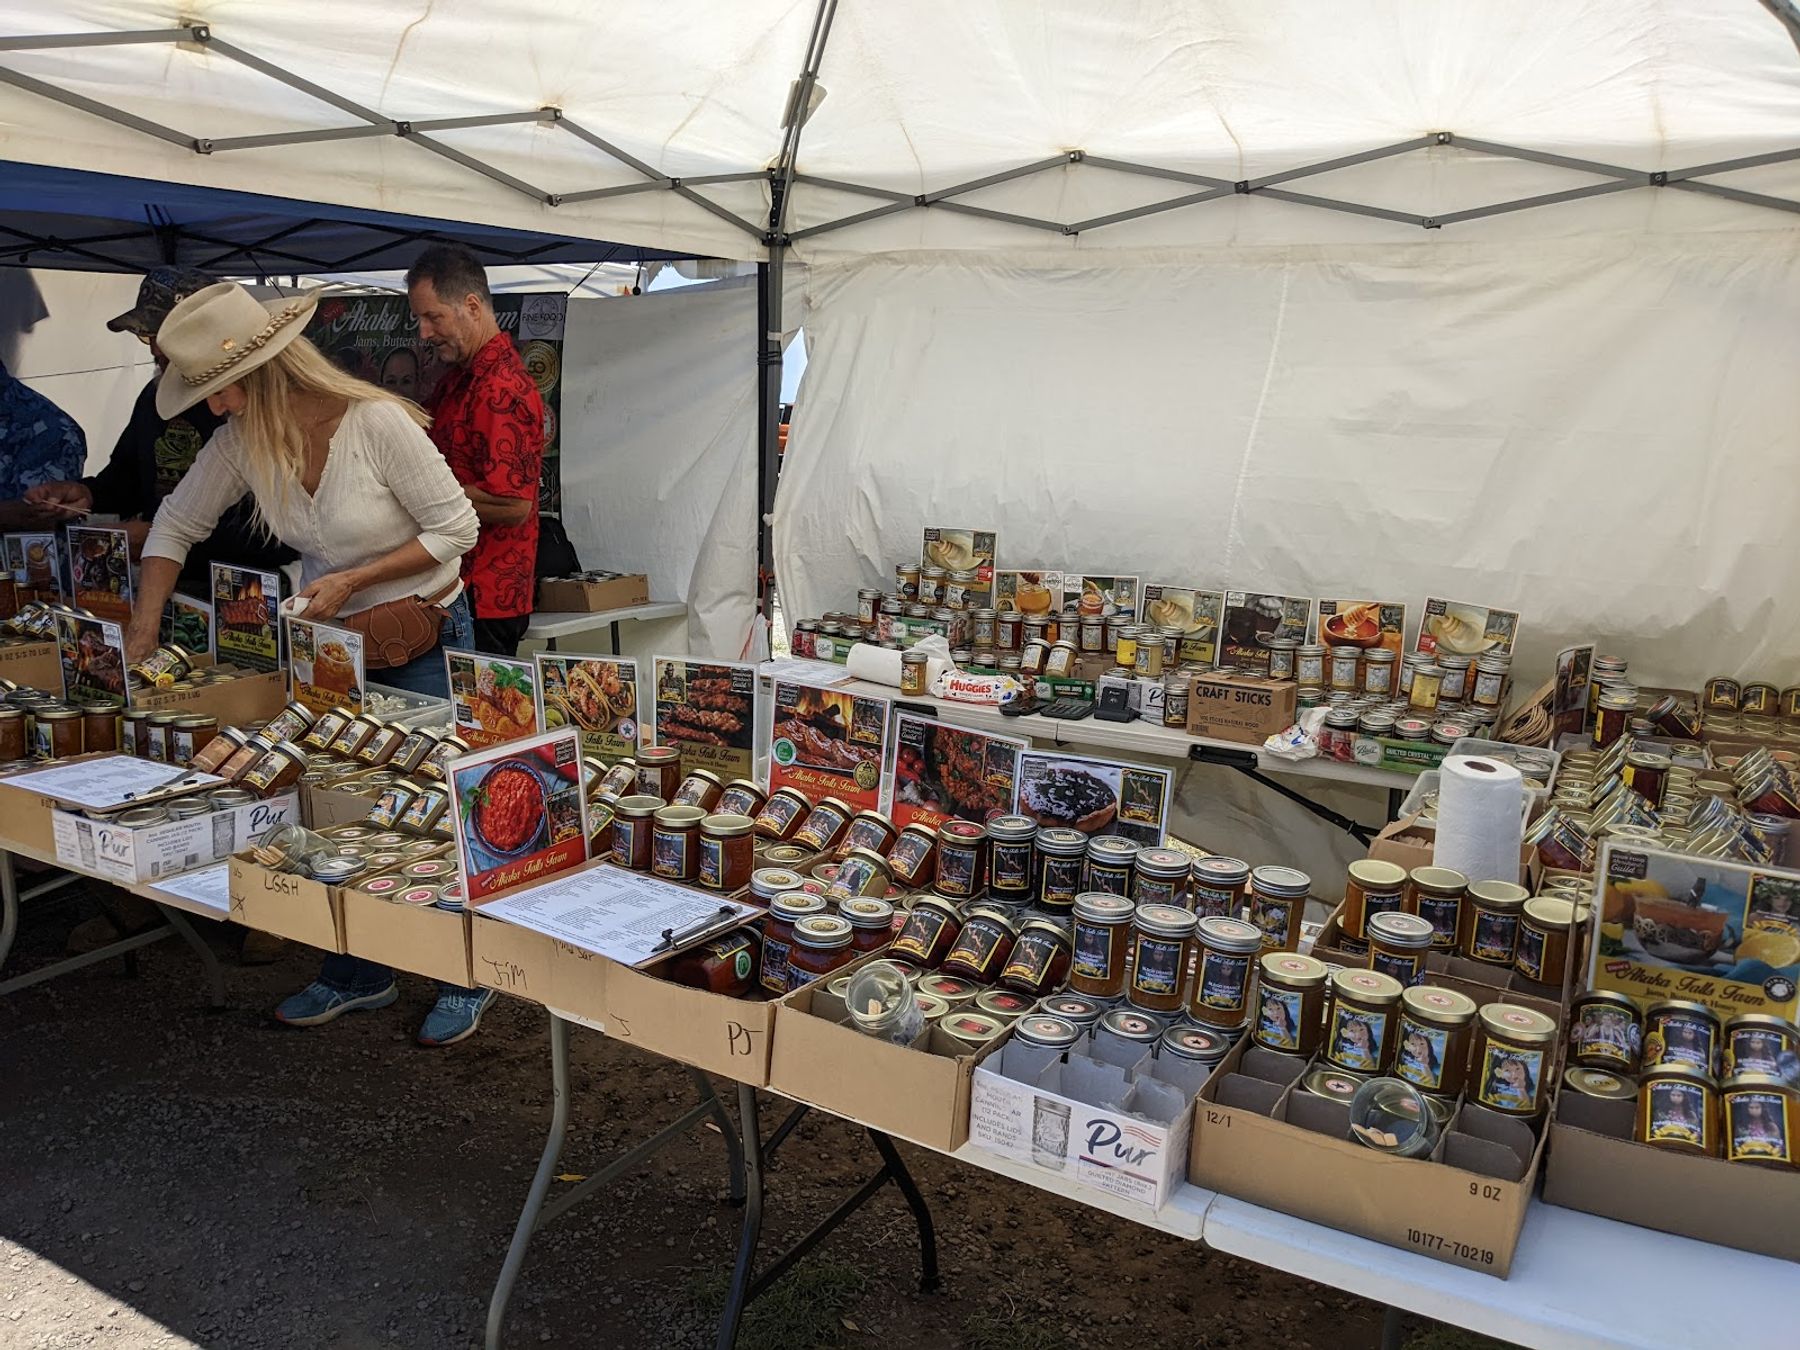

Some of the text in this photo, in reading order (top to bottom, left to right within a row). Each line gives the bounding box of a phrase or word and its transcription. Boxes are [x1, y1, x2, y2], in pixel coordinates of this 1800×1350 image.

[331, 299, 400, 333] Akaka
[354, 335, 416, 348] Jams, Butters
[949, 680, 991, 693] HUGGIES
[1196, 686, 1272, 706] CRAFT STICKS
[585, 733, 603, 746] Falls
[605, 736, 626, 748] Farm
[699, 745, 716, 757] Falls
[718, 748, 740, 762] Farm
[1356, 745, 1378, 756] Ball
[1386, 747, 1407, 757] QUILTED
[1408, 750, 1430, 760] CRYSTAL
[817, 775, 837, 788] Falls
[838, 780, 862, 793] Farm
[249, 805, 288, 832] Pur
[911, 809, 942, 826] Akaka
[98, 829, 127, 858] Pur
[490, 851, 568, 889] Akaka Falls Farm
[1610, 863, 1636, 874] Guild
[1616, 965, 1671, 988] Akaka
[1676, 976, 1715, 997] Falls
[1719, 985, 1765, 1006] Farm
[1710, 1000, 1737, 1012] Honey
[726, 1021, 763, 1056] PJ
[1011, 1109, 1022, 1117] AR
[1205, 1110, 1231, 1128] 12/1
[972, 1114, 1022, 1135] INCLUDES LIDS
[976, 1123, 1017, 1141] AND BANDS
[1085, 1119, 1156, 1166] Pur
[1087, 1170, 1114, 1183] QUILTED
[1114, 1179, 1146, 1194] DIAMOND
[1469, 1182, 1501, 1201] 9 OZ
[1407, 1228, 1494, 1265] 10177-70219
